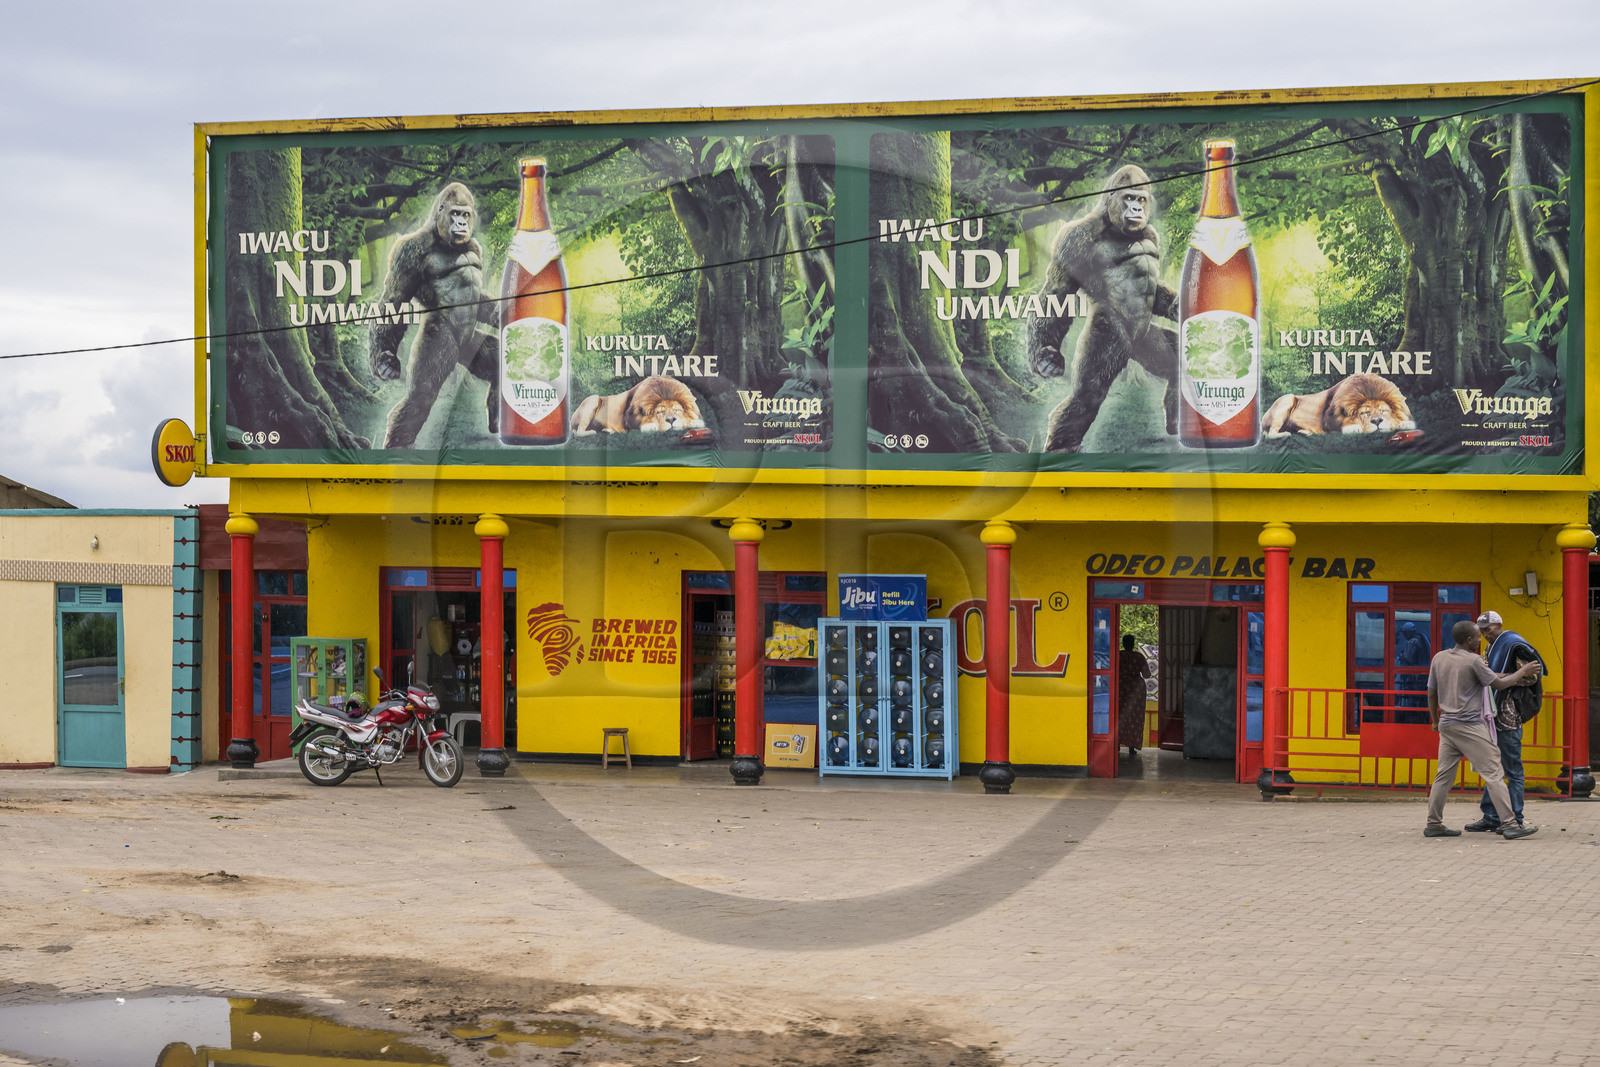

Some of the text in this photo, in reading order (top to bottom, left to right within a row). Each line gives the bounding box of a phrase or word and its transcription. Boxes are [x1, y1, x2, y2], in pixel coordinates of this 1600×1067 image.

[878, 217, 984, 243] IWACU
[238, 230, 330, 254] IWACU
[274, 259, 362, 298] NDI
[919, 248, 1020, 290] NDI
[288, 302, 420, 326] UMWAMI
[936, 293, 1088, 321] UMWAMI
[586, 334, 670, 352] KURUTA
[1280, 329, 1375, 347] KURUTA
[614, 355, 719, 378] INTARE
[1312, 350, 1433, 375] INTARE
[512, 384, 557, 402] Virunga
[1192, 382, 1246, 402] Virunga
[736, 390, 823, 420] Virunga
[1452, 388, 1552, 420] Virunga
[794, 434, 822, 445] SKOL
[1519, 435, 1552, 447] SKOL
[165, 444, 196, 463] SKOL
[1086, 553, 1165, 576] ODEO
[1301, 558, 1376, 579] BAR
[842, 586, 876, 608] Jibu
[592, 618, 678, 634] BREWED
[591, 634, 678, 649] IN AFRICA
[588, 648, 677, 664] SINCE 1965
